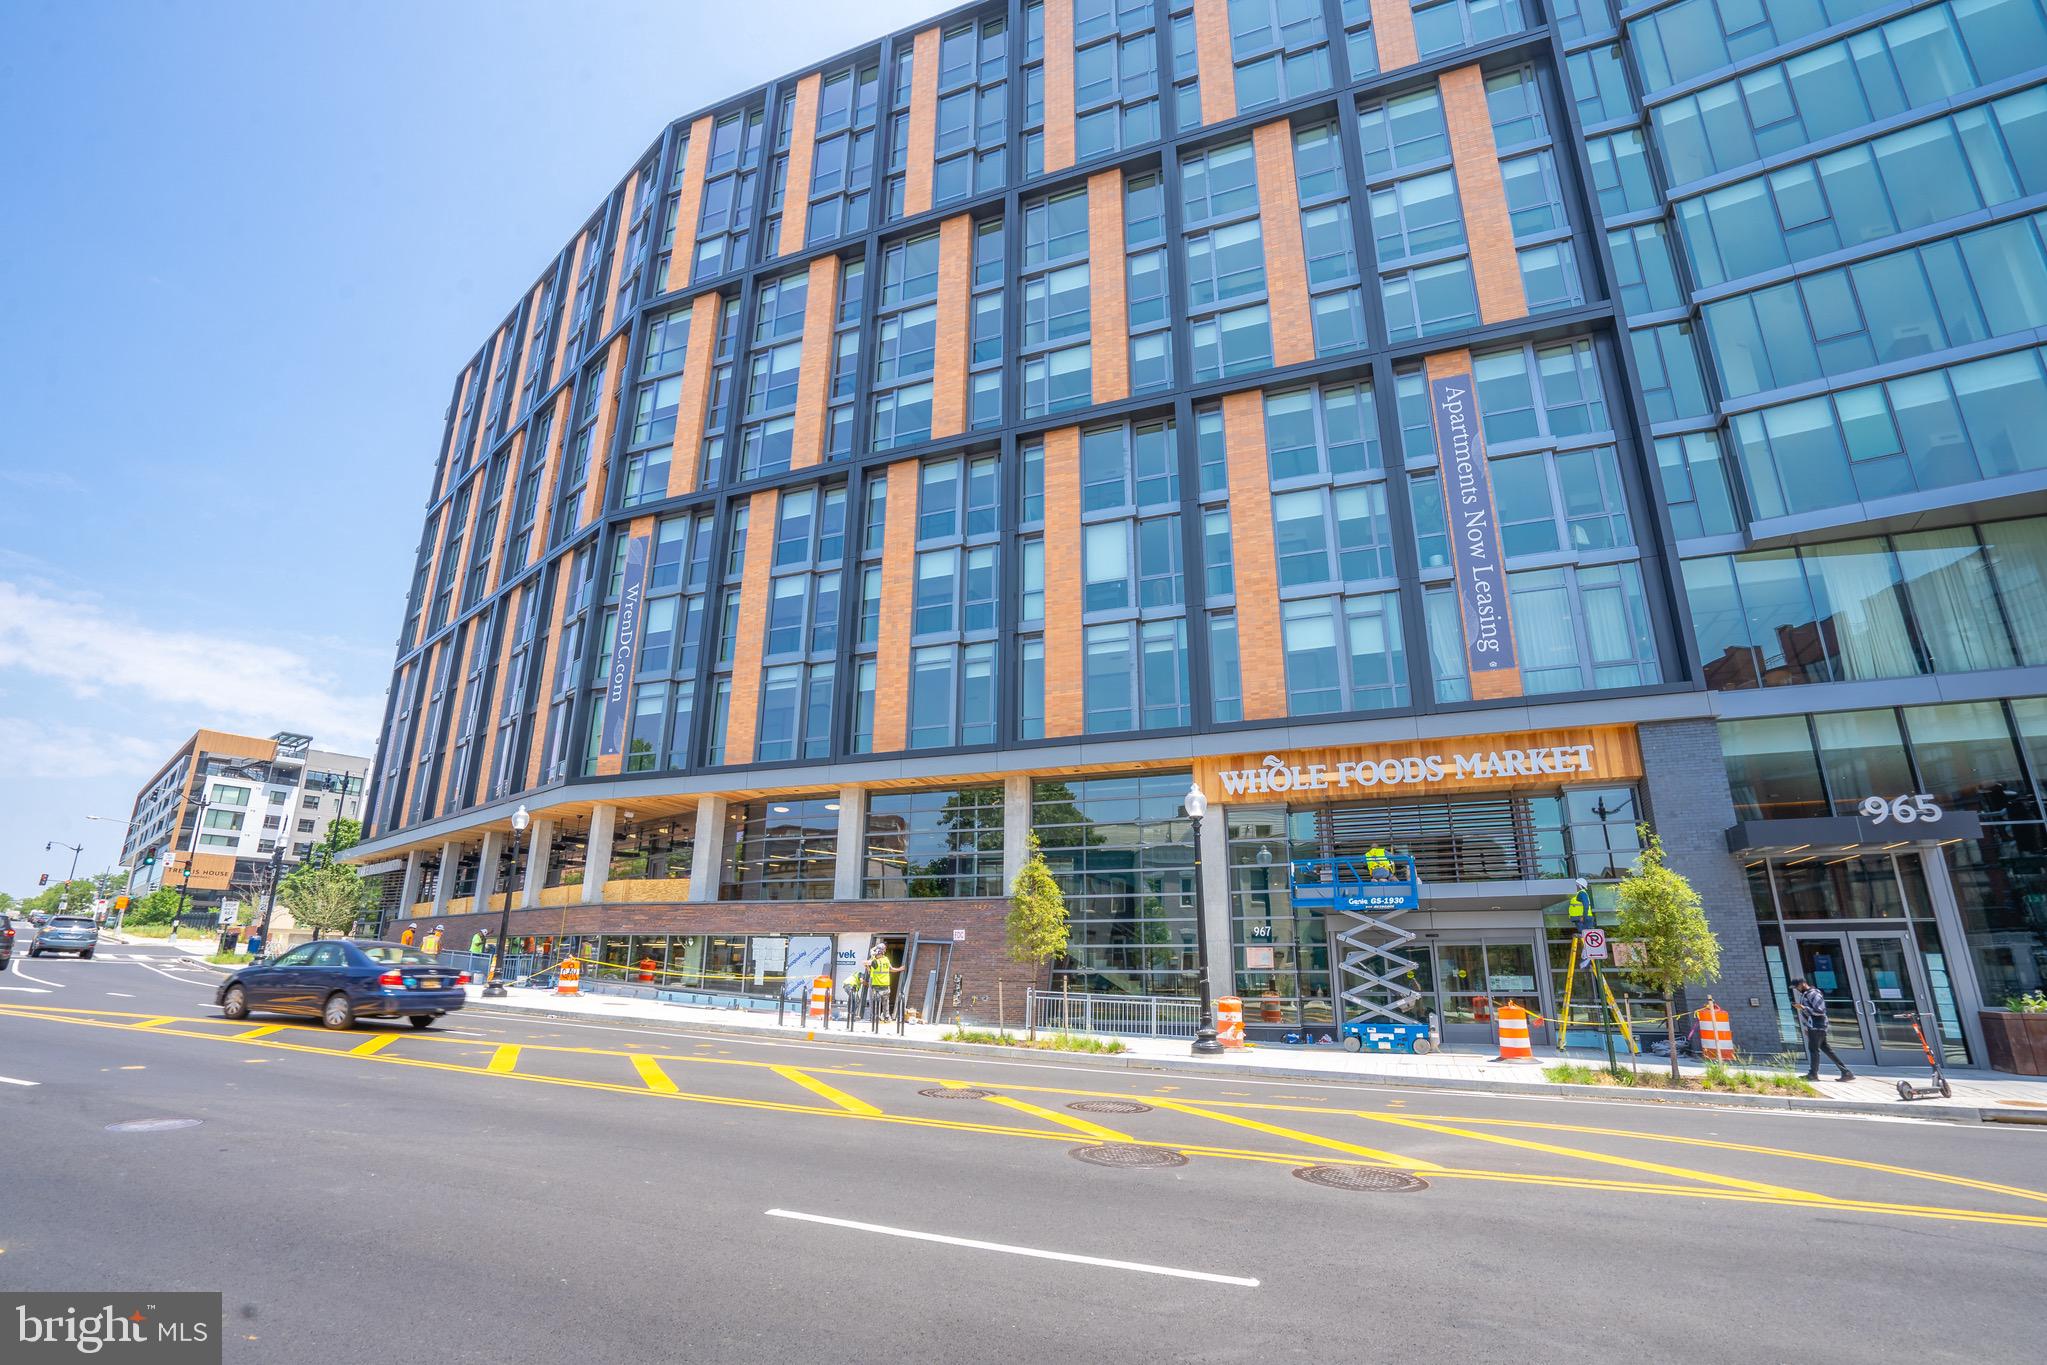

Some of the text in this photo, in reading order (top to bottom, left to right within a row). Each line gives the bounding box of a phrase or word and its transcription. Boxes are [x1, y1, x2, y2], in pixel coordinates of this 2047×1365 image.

[1442, 386, 1502, 652] Apartments Now Leasing
[612, 582, 640, 703] WrenDC.com
[1219, 744, 1594, 795] WHOLE FOODS MARKET
[1864, 793, 1943, 825] 965
[168, 867, 200, 875] TREIS
[1370, 896, 1405, 905] GS-1930
[1253, 926, 1272, 937] 967
[837, 949, 856, 959] vek
